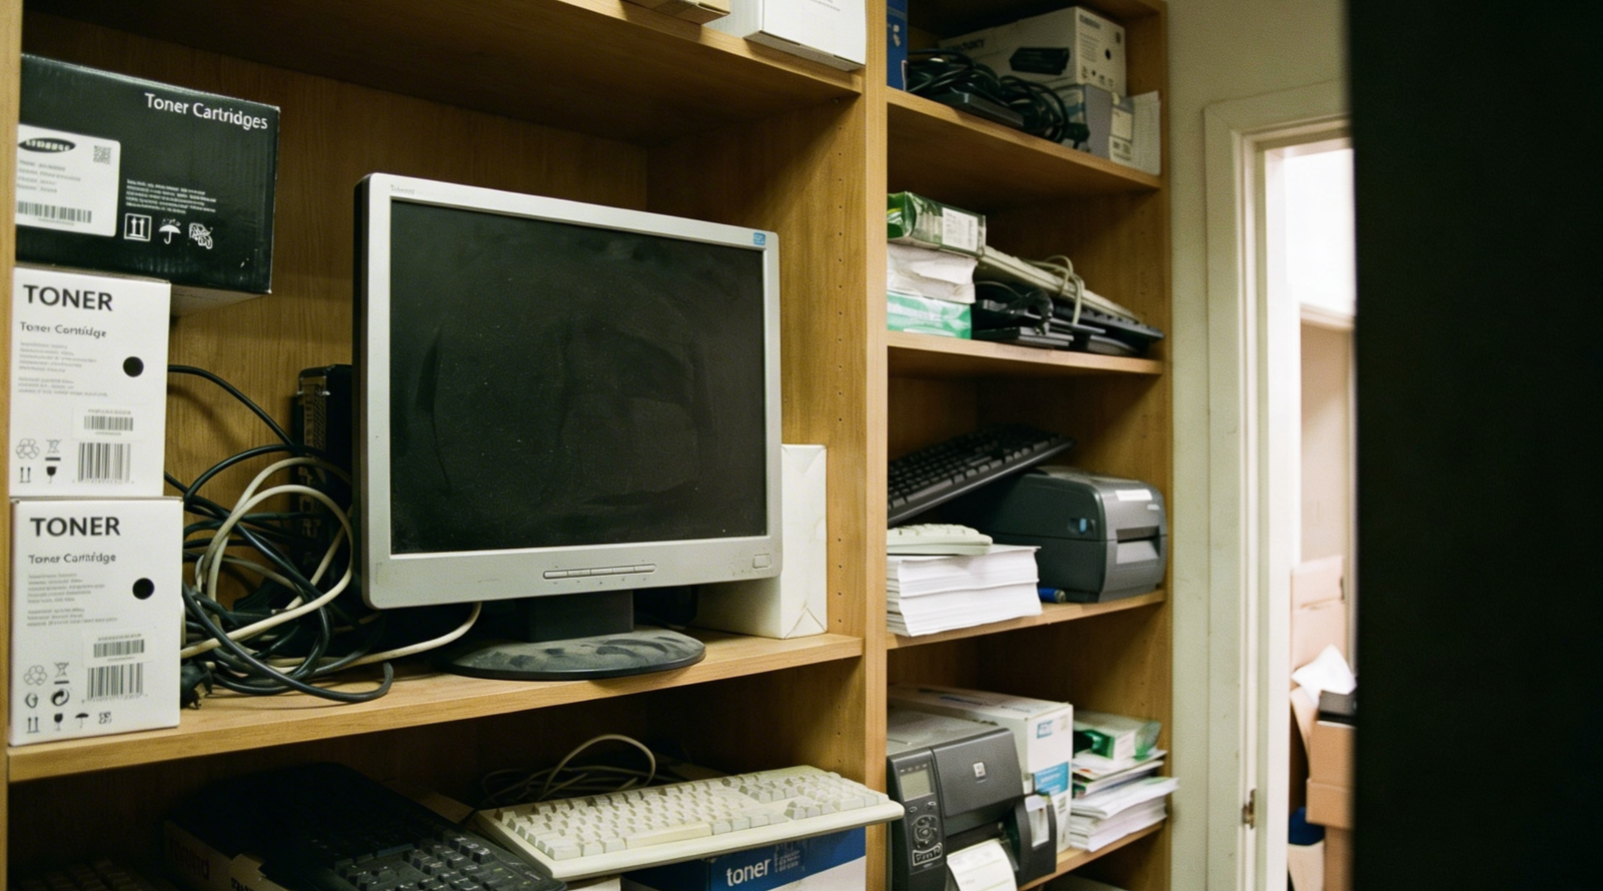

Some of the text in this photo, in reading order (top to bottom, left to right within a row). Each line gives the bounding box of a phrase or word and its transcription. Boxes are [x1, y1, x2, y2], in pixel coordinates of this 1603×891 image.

[144, 92, 268, 130] Toner Cartridges
[22, 284, 113, 311] TONER
[30, 516, 121, 537] TONER
[28, 554, 60, 565] Toner
[726, 858, 771, 887] toner
